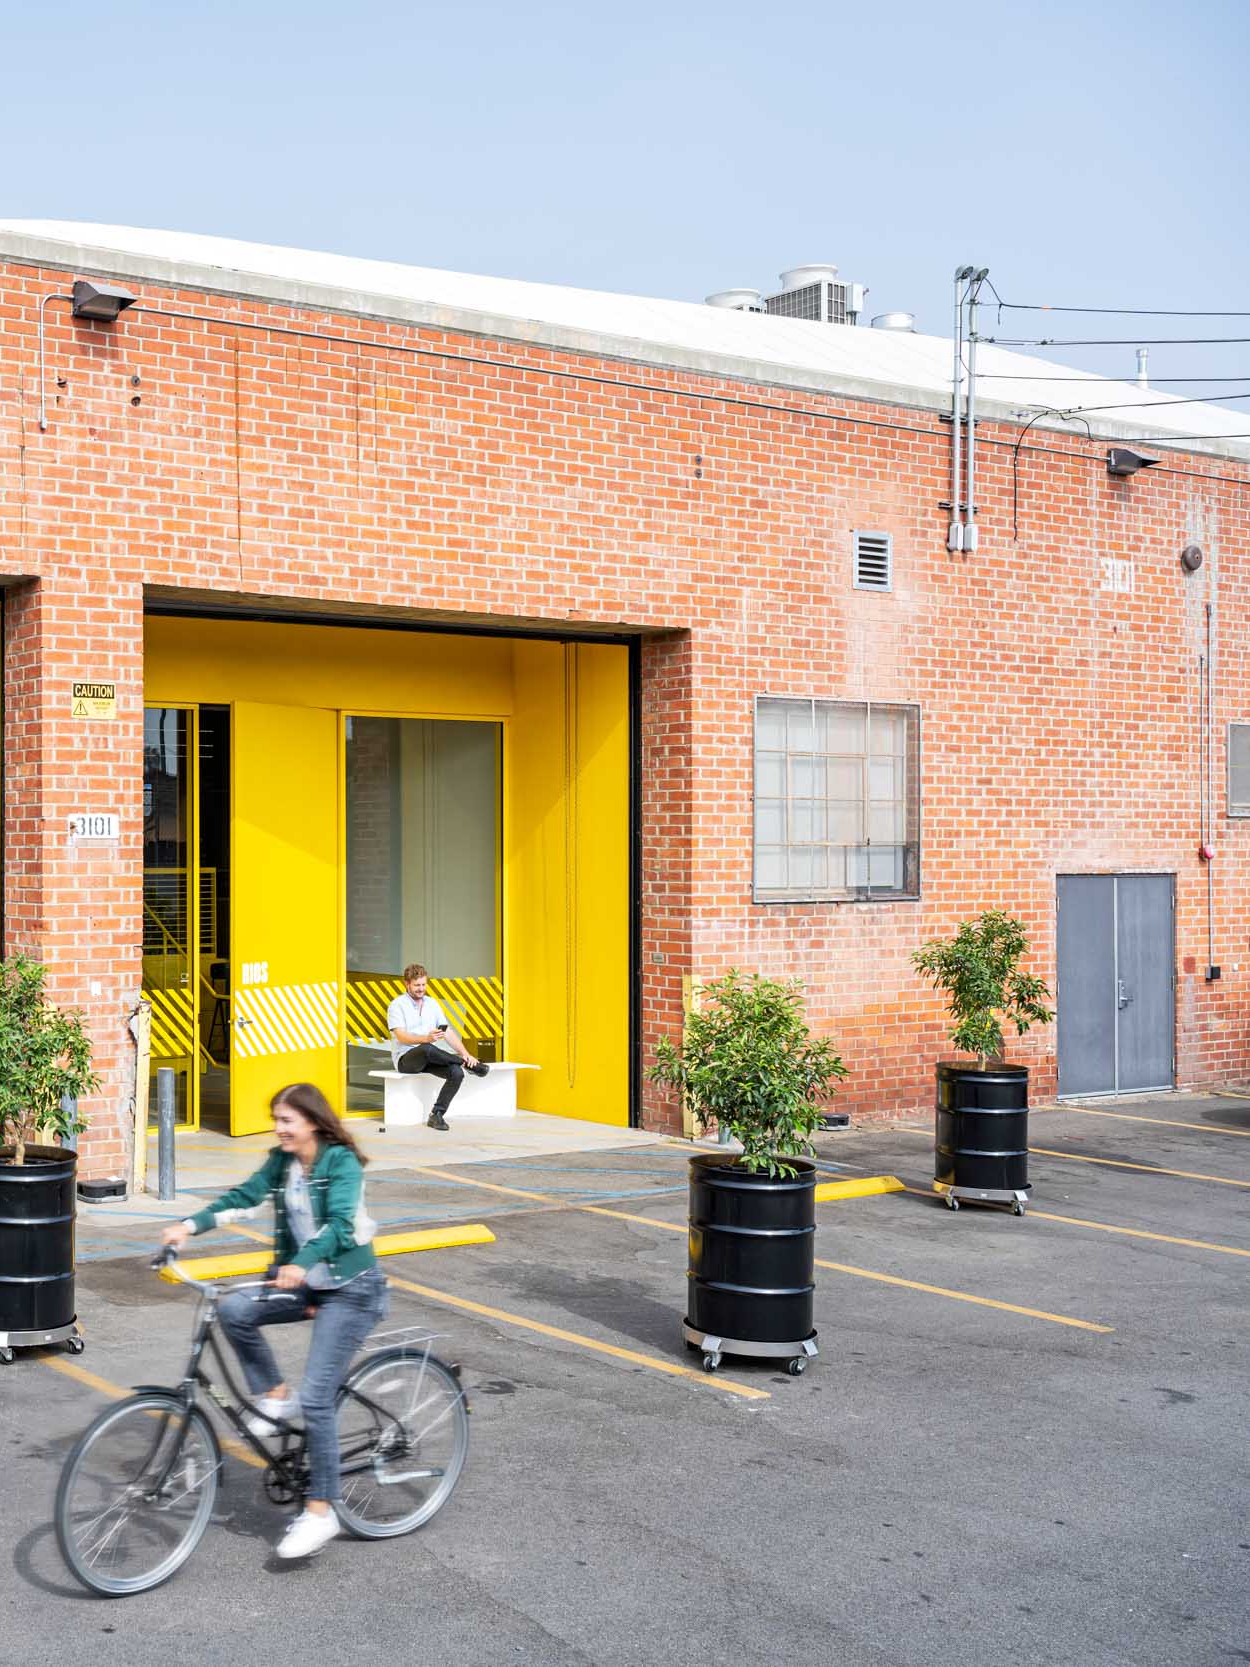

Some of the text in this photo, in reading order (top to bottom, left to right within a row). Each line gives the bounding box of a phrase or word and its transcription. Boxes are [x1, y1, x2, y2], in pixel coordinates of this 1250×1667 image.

[1100, 557, 1134, 593] 3101
[75, 684, 113, 698] CAUTION
[76, 816, 111, 836] 3101
[241, 960, 269, 985] RIOS
